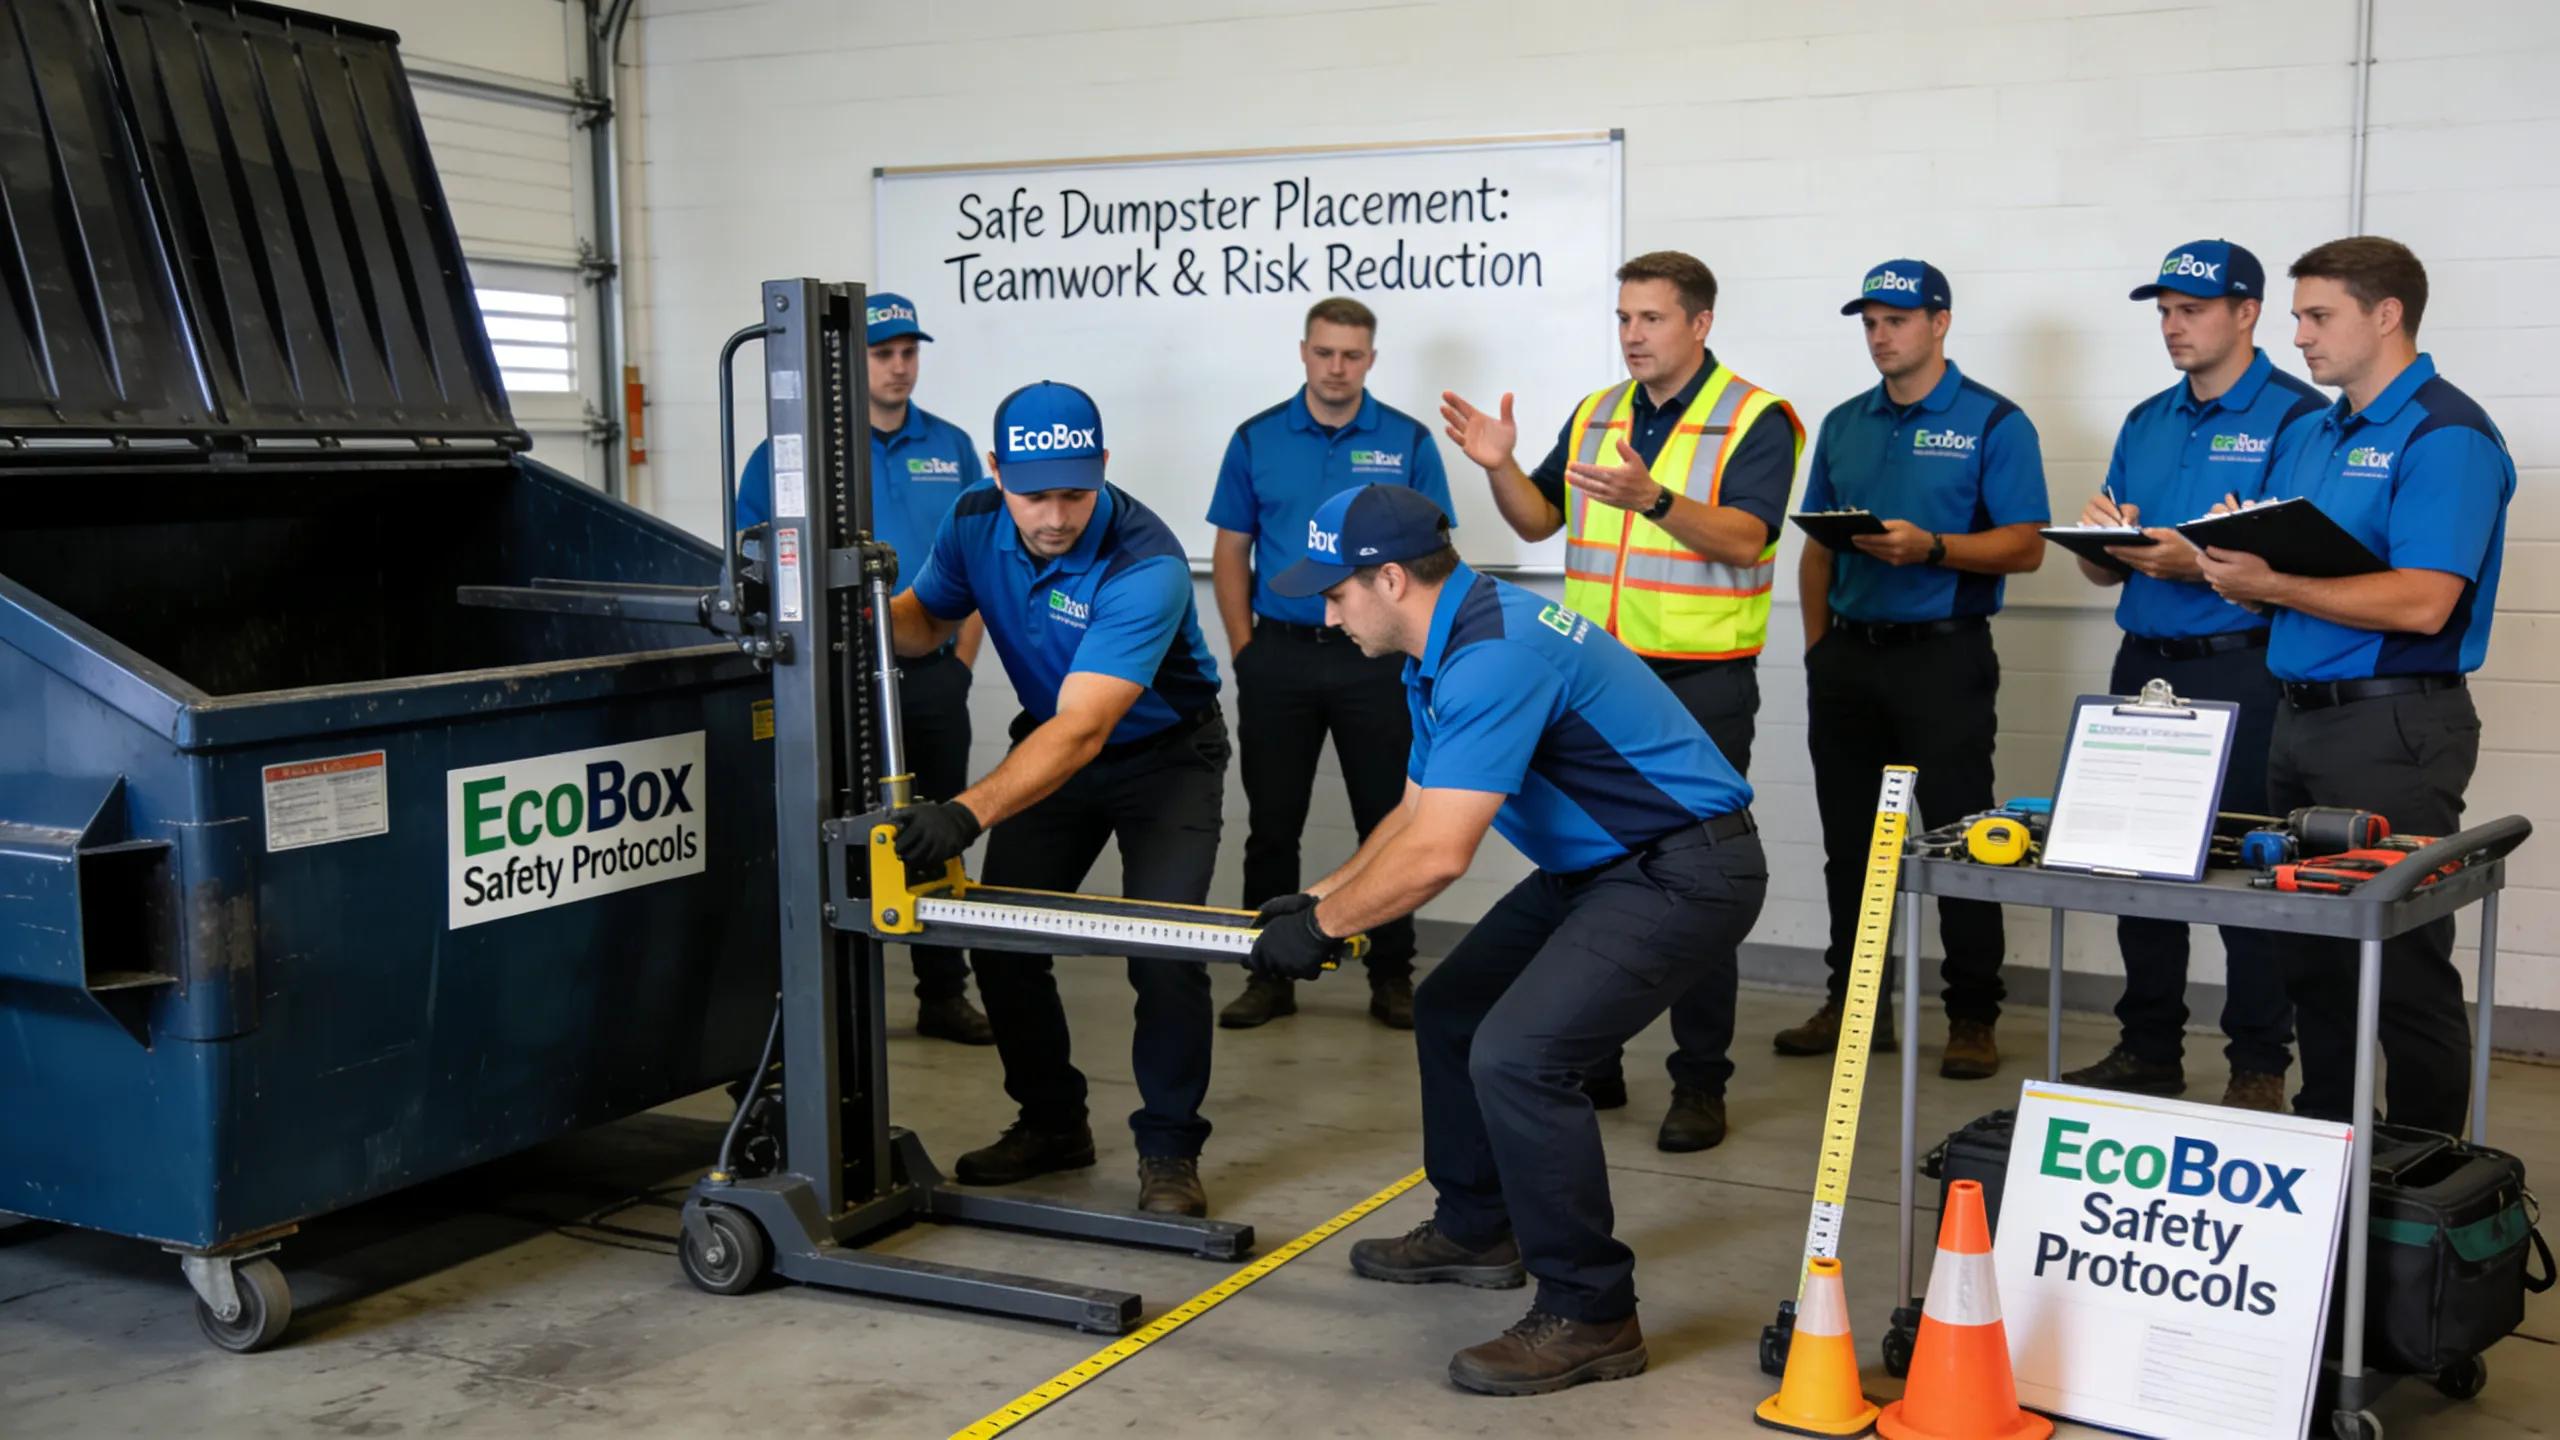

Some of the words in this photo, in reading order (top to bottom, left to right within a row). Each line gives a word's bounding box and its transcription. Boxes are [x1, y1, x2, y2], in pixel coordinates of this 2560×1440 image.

[958, 187, 1044, 242] Safe
[1060, 187, 1260, 250] Dumpster
[1274, 176, 1510, 231] Placement:
[944, 247, 1160, 304] Teamwork
[1172, 248, 1208, 297] &
[1222, 242, 1311, 295] Risk
[1326, 239, 1543, 293] Reduction
[1008, 423, 1096, 452] EcoBox
[463, 759, 695, 857] EcoBox
[463, 855, 565, 907] Safety
[572, 823, 699, 884] Protocols
[2039, 1117, 2308, 1215] EcoBox
[2080, 1191, 2245, 1267] Safety
[2033, 1231, 2278, 1317] Protocols
